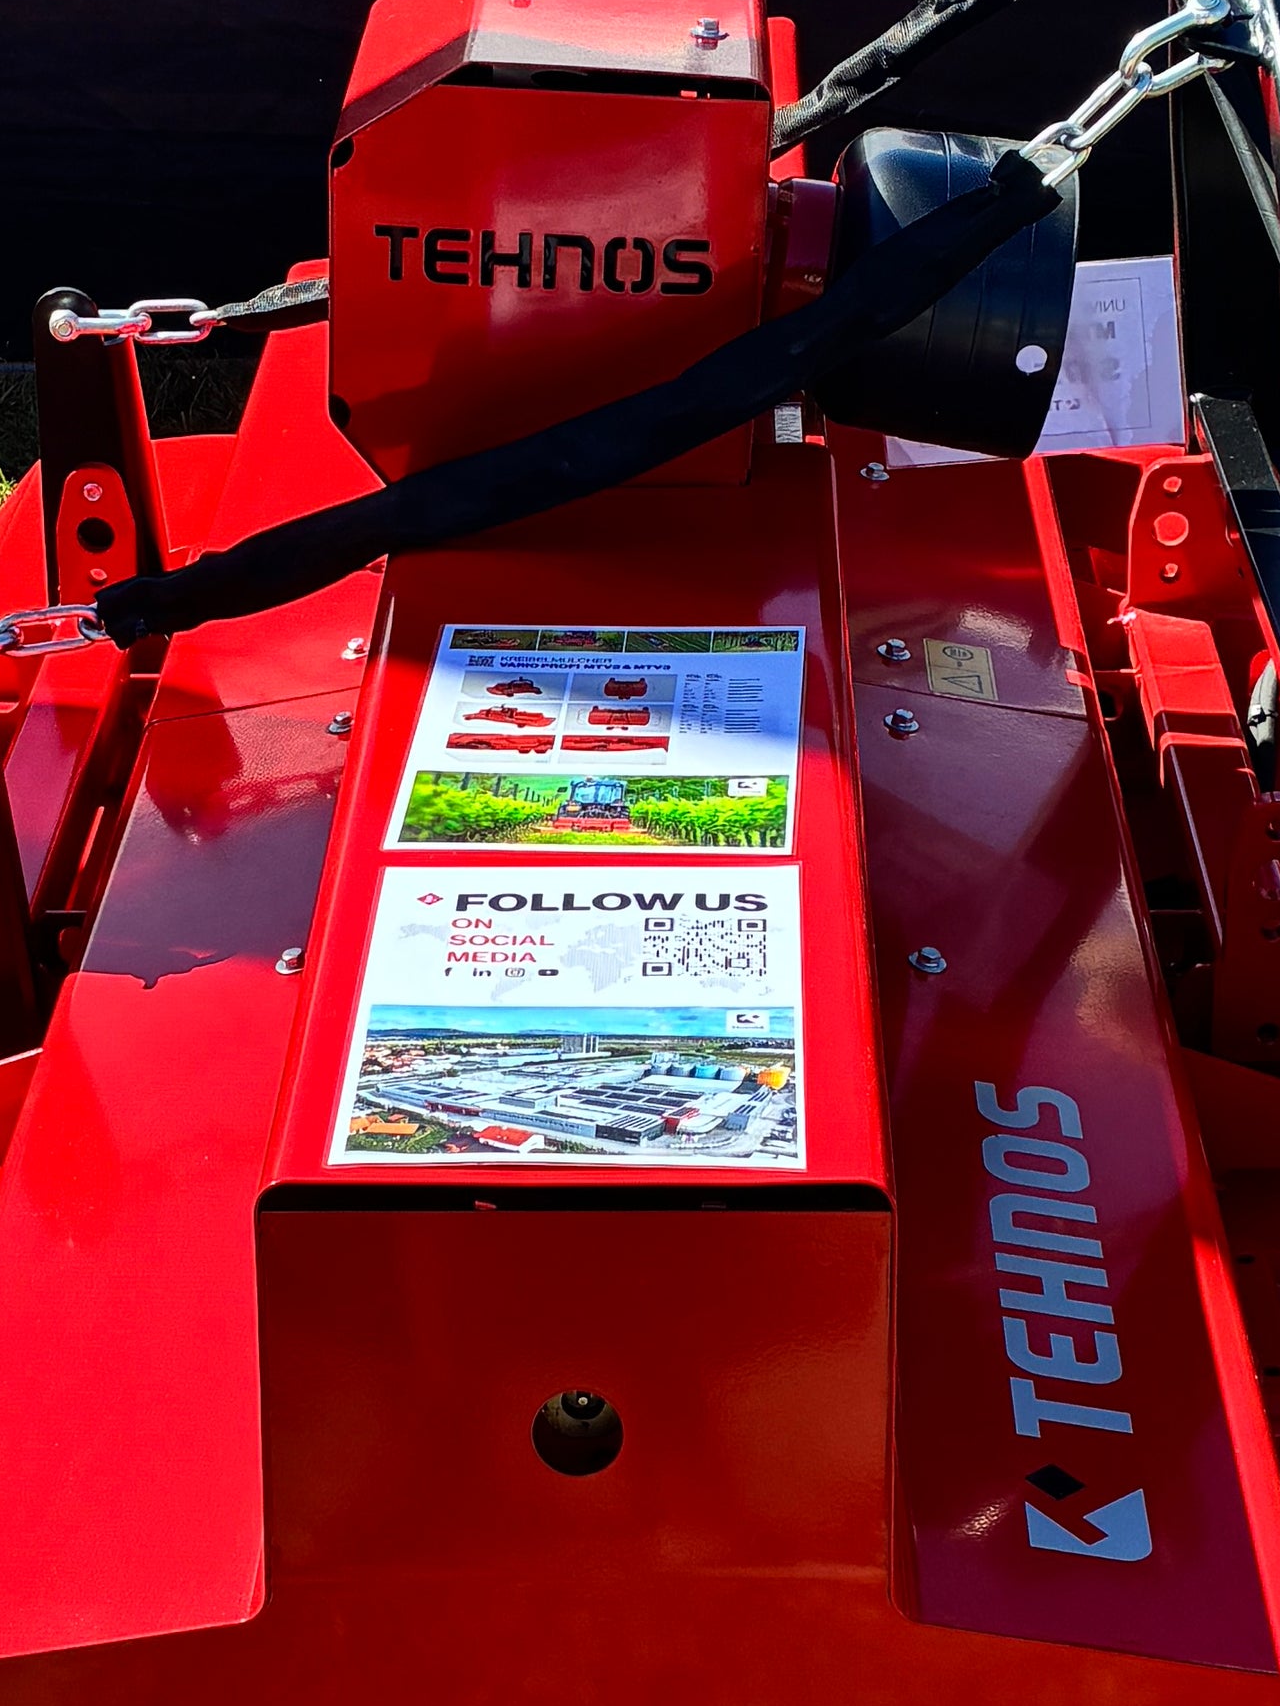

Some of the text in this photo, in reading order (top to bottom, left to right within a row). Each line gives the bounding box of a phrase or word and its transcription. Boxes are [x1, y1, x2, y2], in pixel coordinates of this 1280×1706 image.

[374, 224, 715, 296] TEHNOS
[456, 893, 768, 912] FOLLOW US
[451, 918, 493, 929] ON
[449, 935, 555, 946] SOCIAL
[447, 951, 537, 963] MEDIA
[974, 1081, 1133, 1438] TEHNOS
